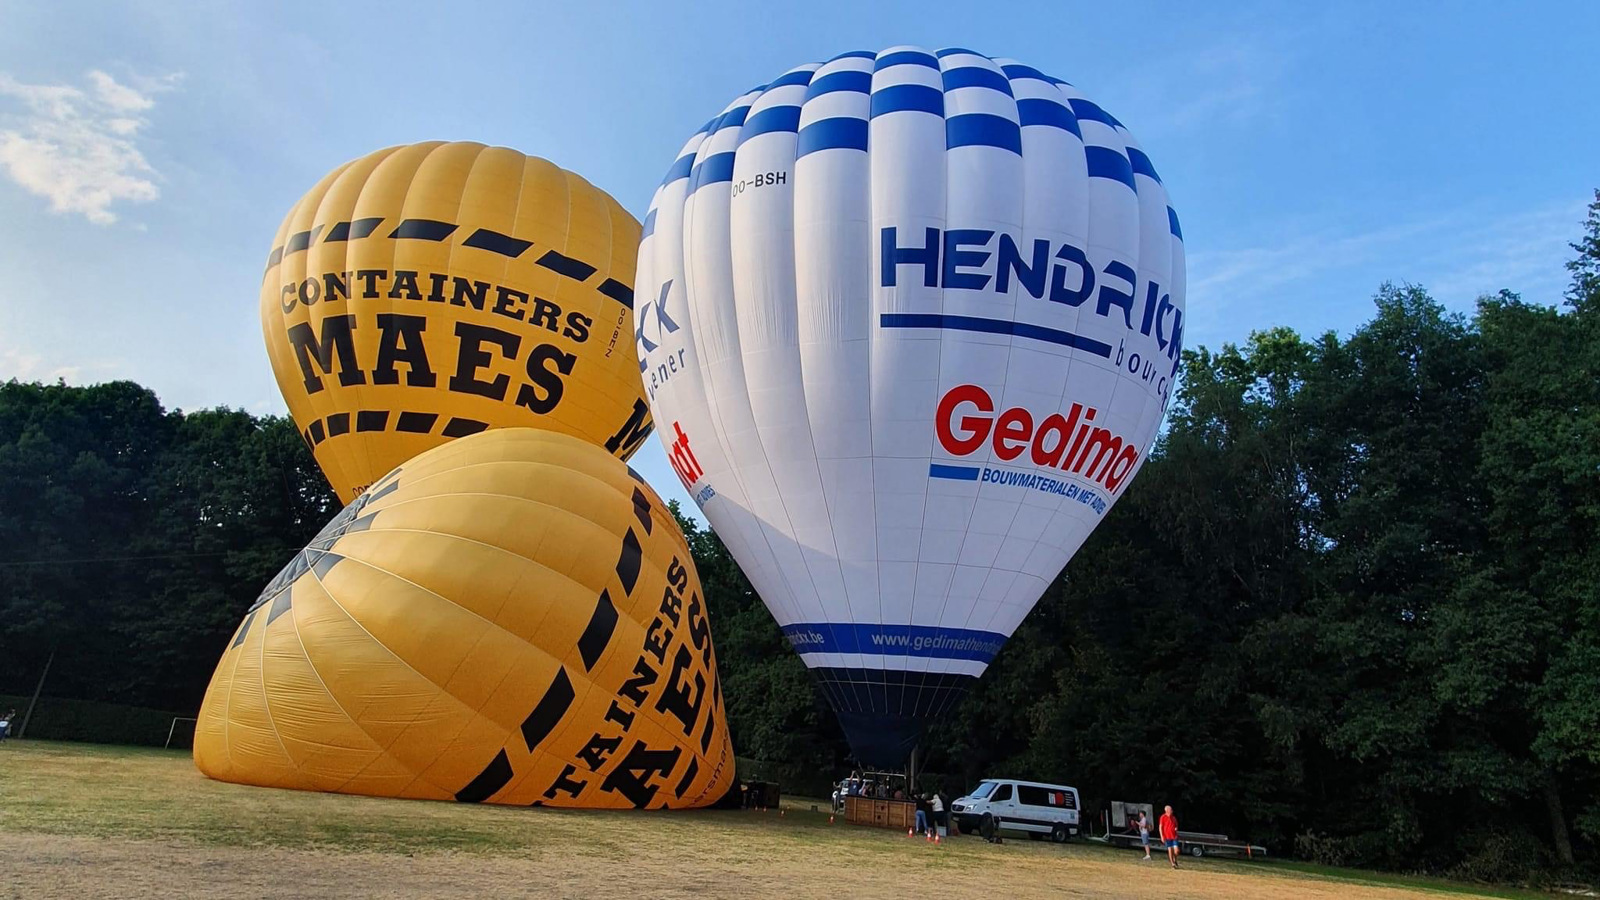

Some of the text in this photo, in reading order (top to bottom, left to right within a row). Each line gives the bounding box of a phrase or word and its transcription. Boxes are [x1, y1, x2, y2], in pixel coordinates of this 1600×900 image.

[733, 171, 786, 197] OO-BSH
[281, 269, 594, 343] CONTAINERS
[288, 313, 577, 415] MAES
[935, 384, 1145, 496] Gedima
[982, 466, 1081, 499] BOUWMATERIALEN
[532, 555, 687, 805] TAINERS
[600, 590, 711, 809] AES
